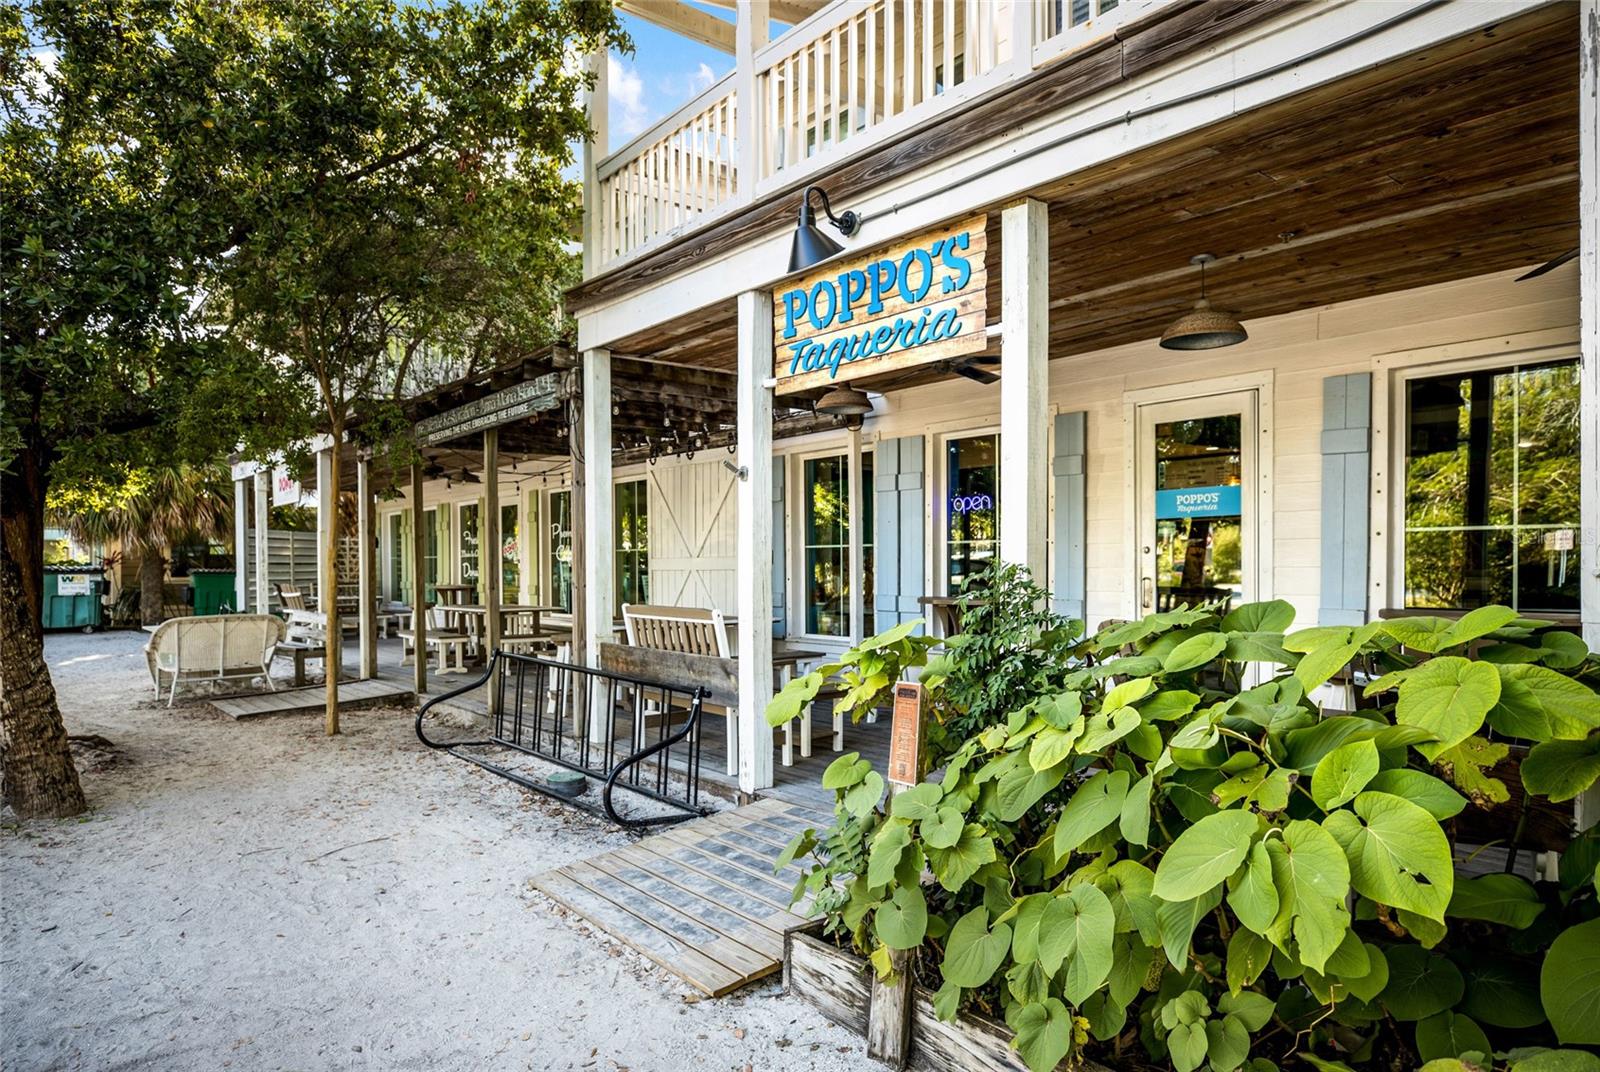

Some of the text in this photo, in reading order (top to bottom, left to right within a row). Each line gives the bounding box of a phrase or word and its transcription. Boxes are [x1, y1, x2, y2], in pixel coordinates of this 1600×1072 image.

[782, 231, 971, 339] POPPO'S
[788, 307, 963, 379] Taqueria
[428, 427, 453, 442] PRESERVING
[471, 412, 497, 429] EMBRACING
[497, 409, 508, 420] THE
[508, 402, 529, 416] FUTURE
[953, 495, 991, 515] open
[1176, 492, 1220, 505] POPPO'S
[1177, 504, 1218, 514] Taqueria
